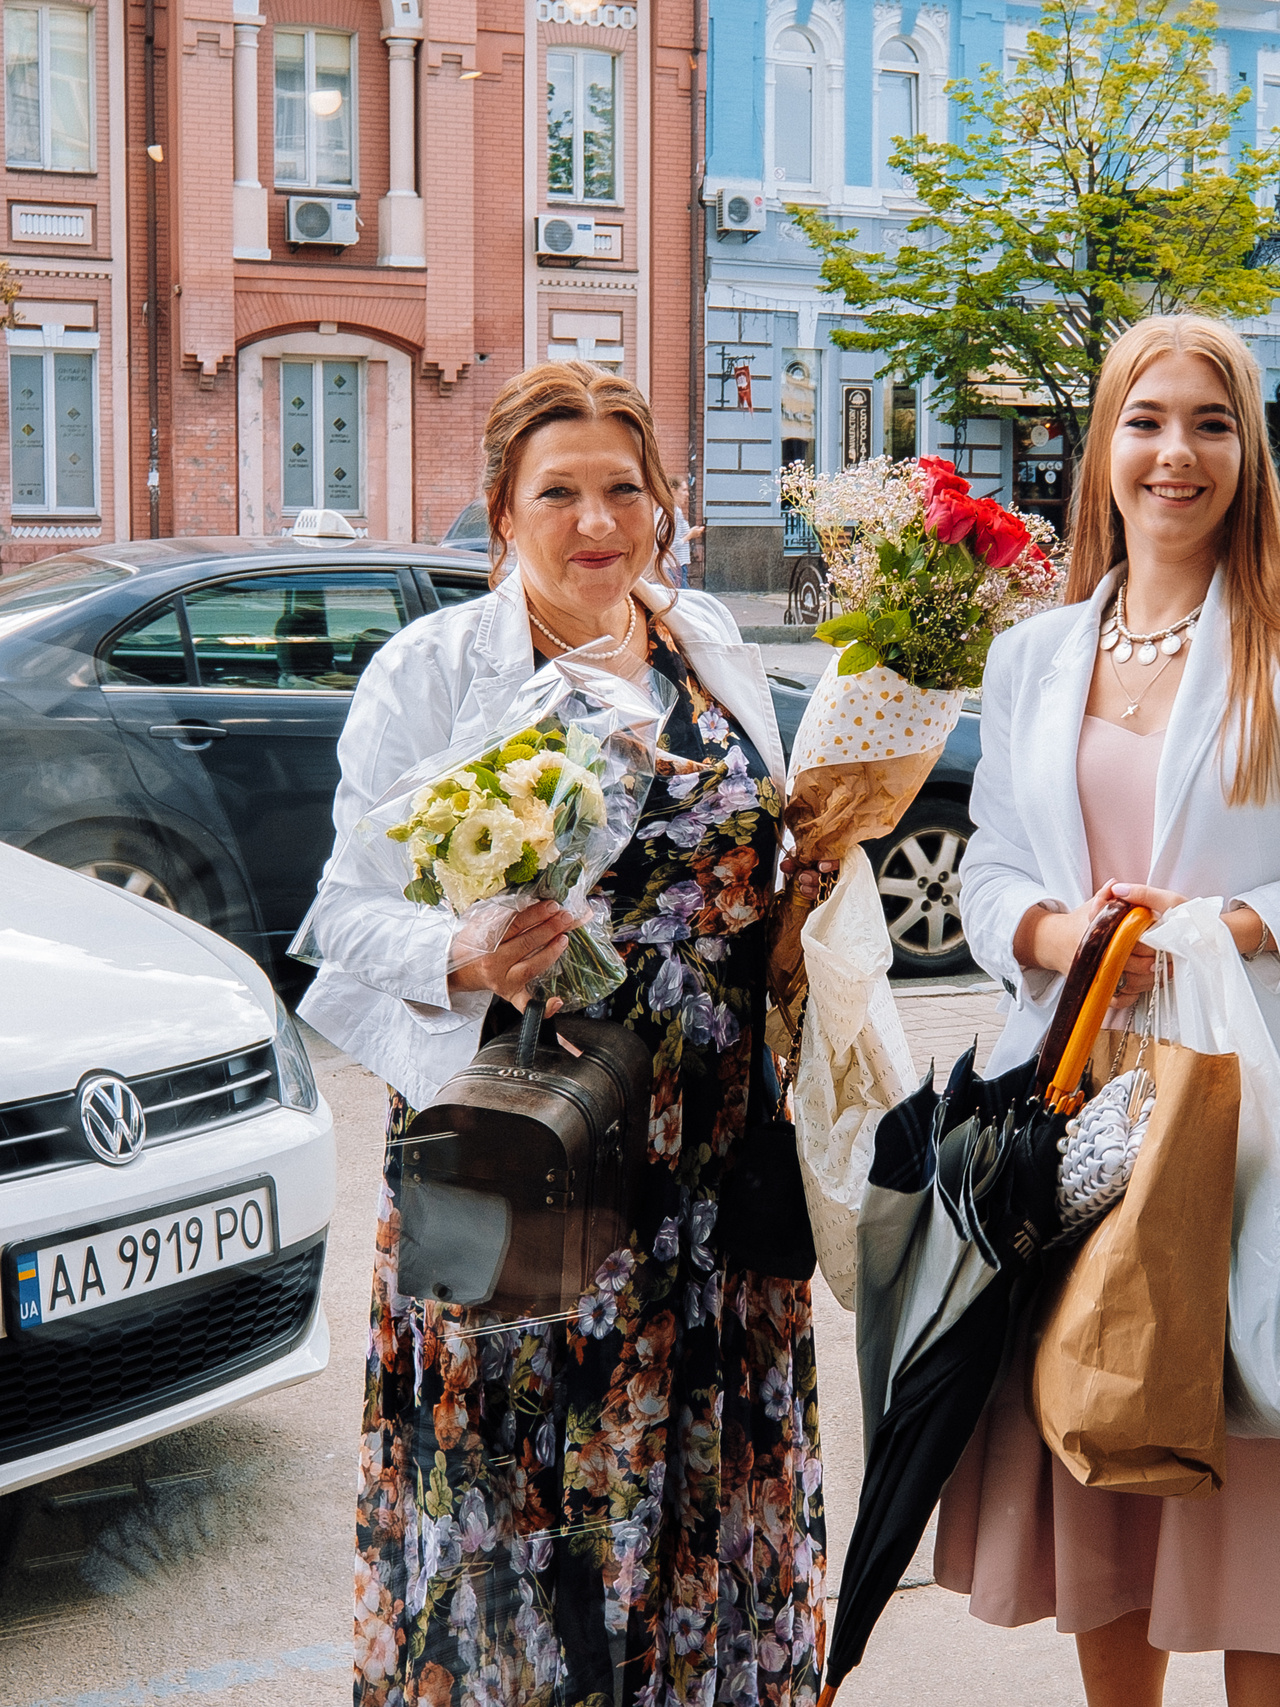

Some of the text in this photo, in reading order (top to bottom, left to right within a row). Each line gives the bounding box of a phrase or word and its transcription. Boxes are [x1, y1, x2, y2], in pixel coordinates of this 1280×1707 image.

[49, 1198, 264, 1313] AA 9919 PO
[20, 1300, 39, 1321] UA
